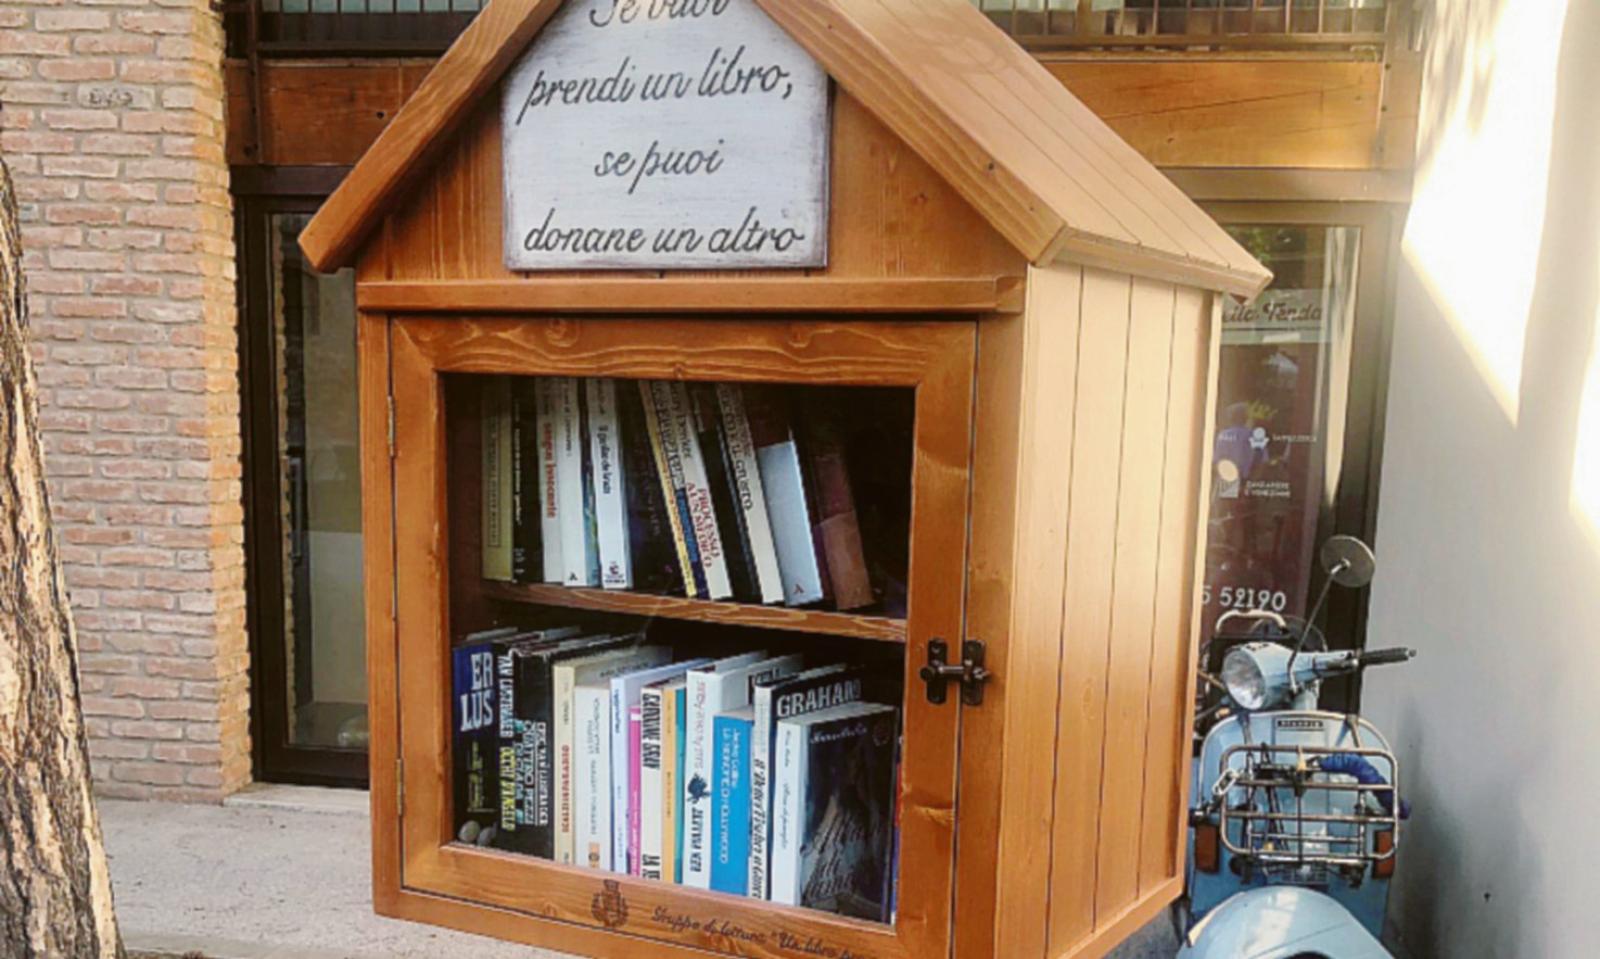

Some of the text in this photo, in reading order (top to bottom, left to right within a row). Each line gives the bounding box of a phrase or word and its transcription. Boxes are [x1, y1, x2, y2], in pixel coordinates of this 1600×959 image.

[515, 45, 793, 126] prendi un libro,
[594, 139, 725, 195] se puoi
[524, 206, 806, 254] donane un altro
[1219, 586, 1287, 611] 52190
[720, 804, 730, 865] HOLLYWOOD
